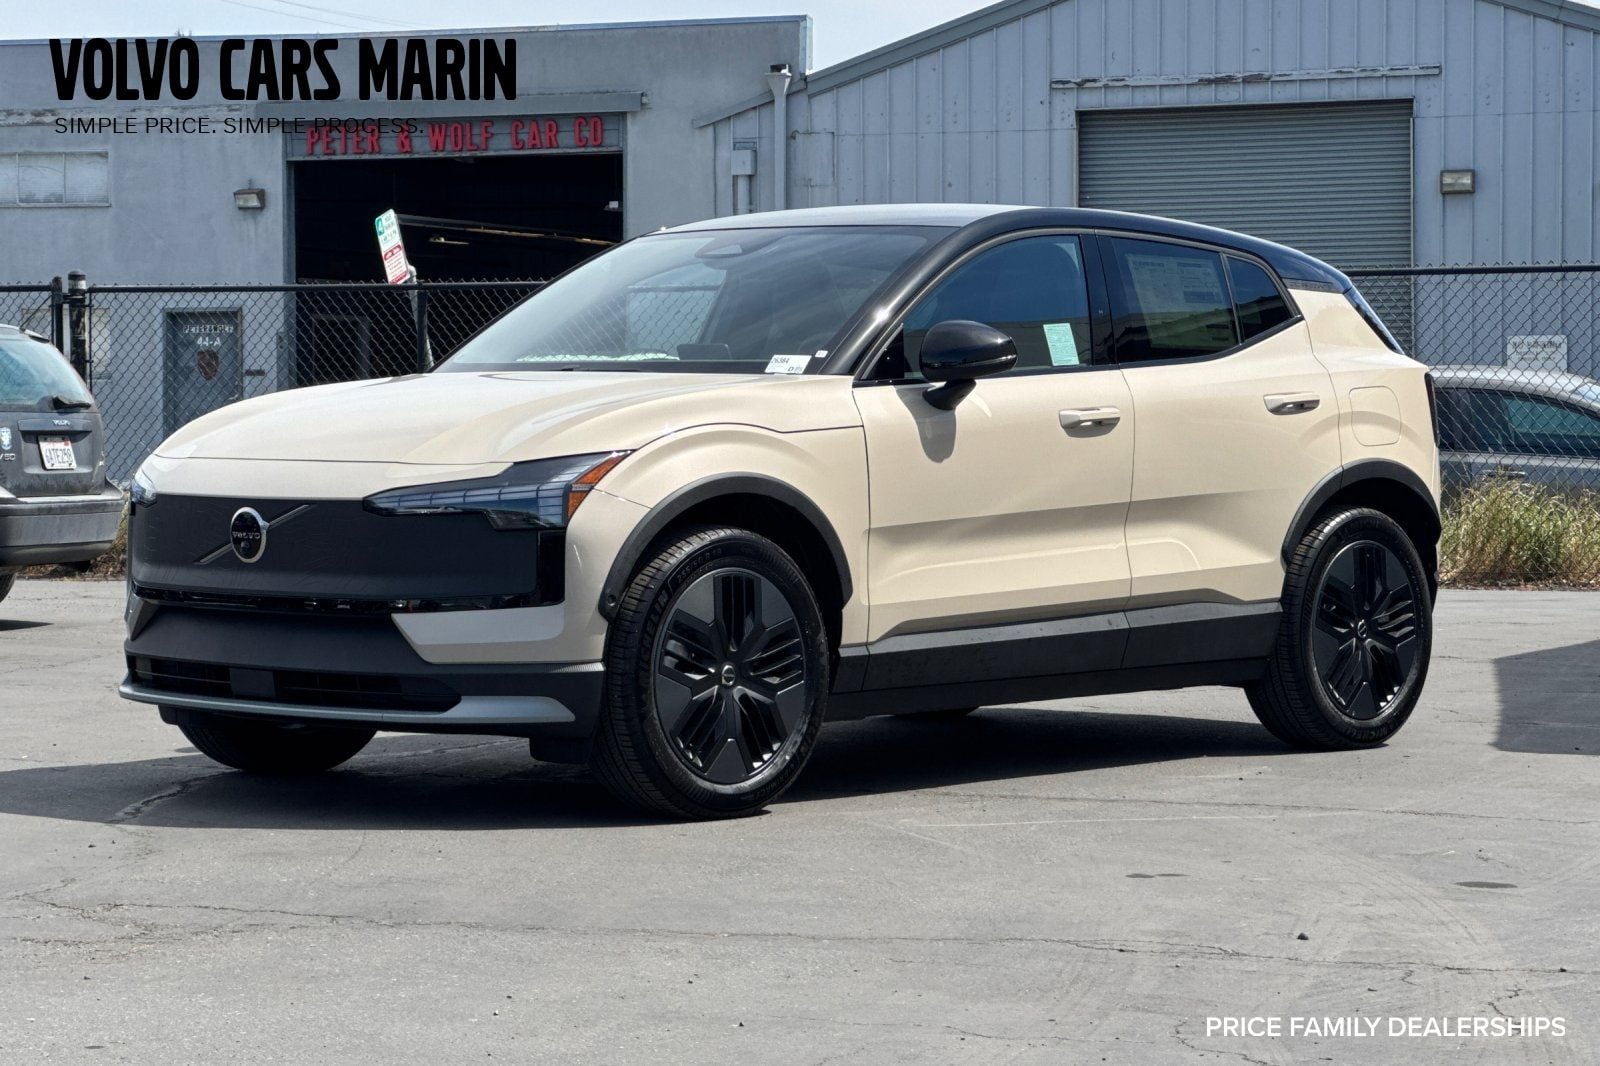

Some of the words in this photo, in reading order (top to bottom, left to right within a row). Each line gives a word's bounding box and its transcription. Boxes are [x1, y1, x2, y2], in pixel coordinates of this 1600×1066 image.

[306, 125, 381, 155] PETER
[396, 124, 412, 153] &
[428, 121, 494, 152] WOLF
[511, 119, 558, 150] CAR
[574, 116, 604, 148] CO
[232, 531, 261, 540] VOLVO
